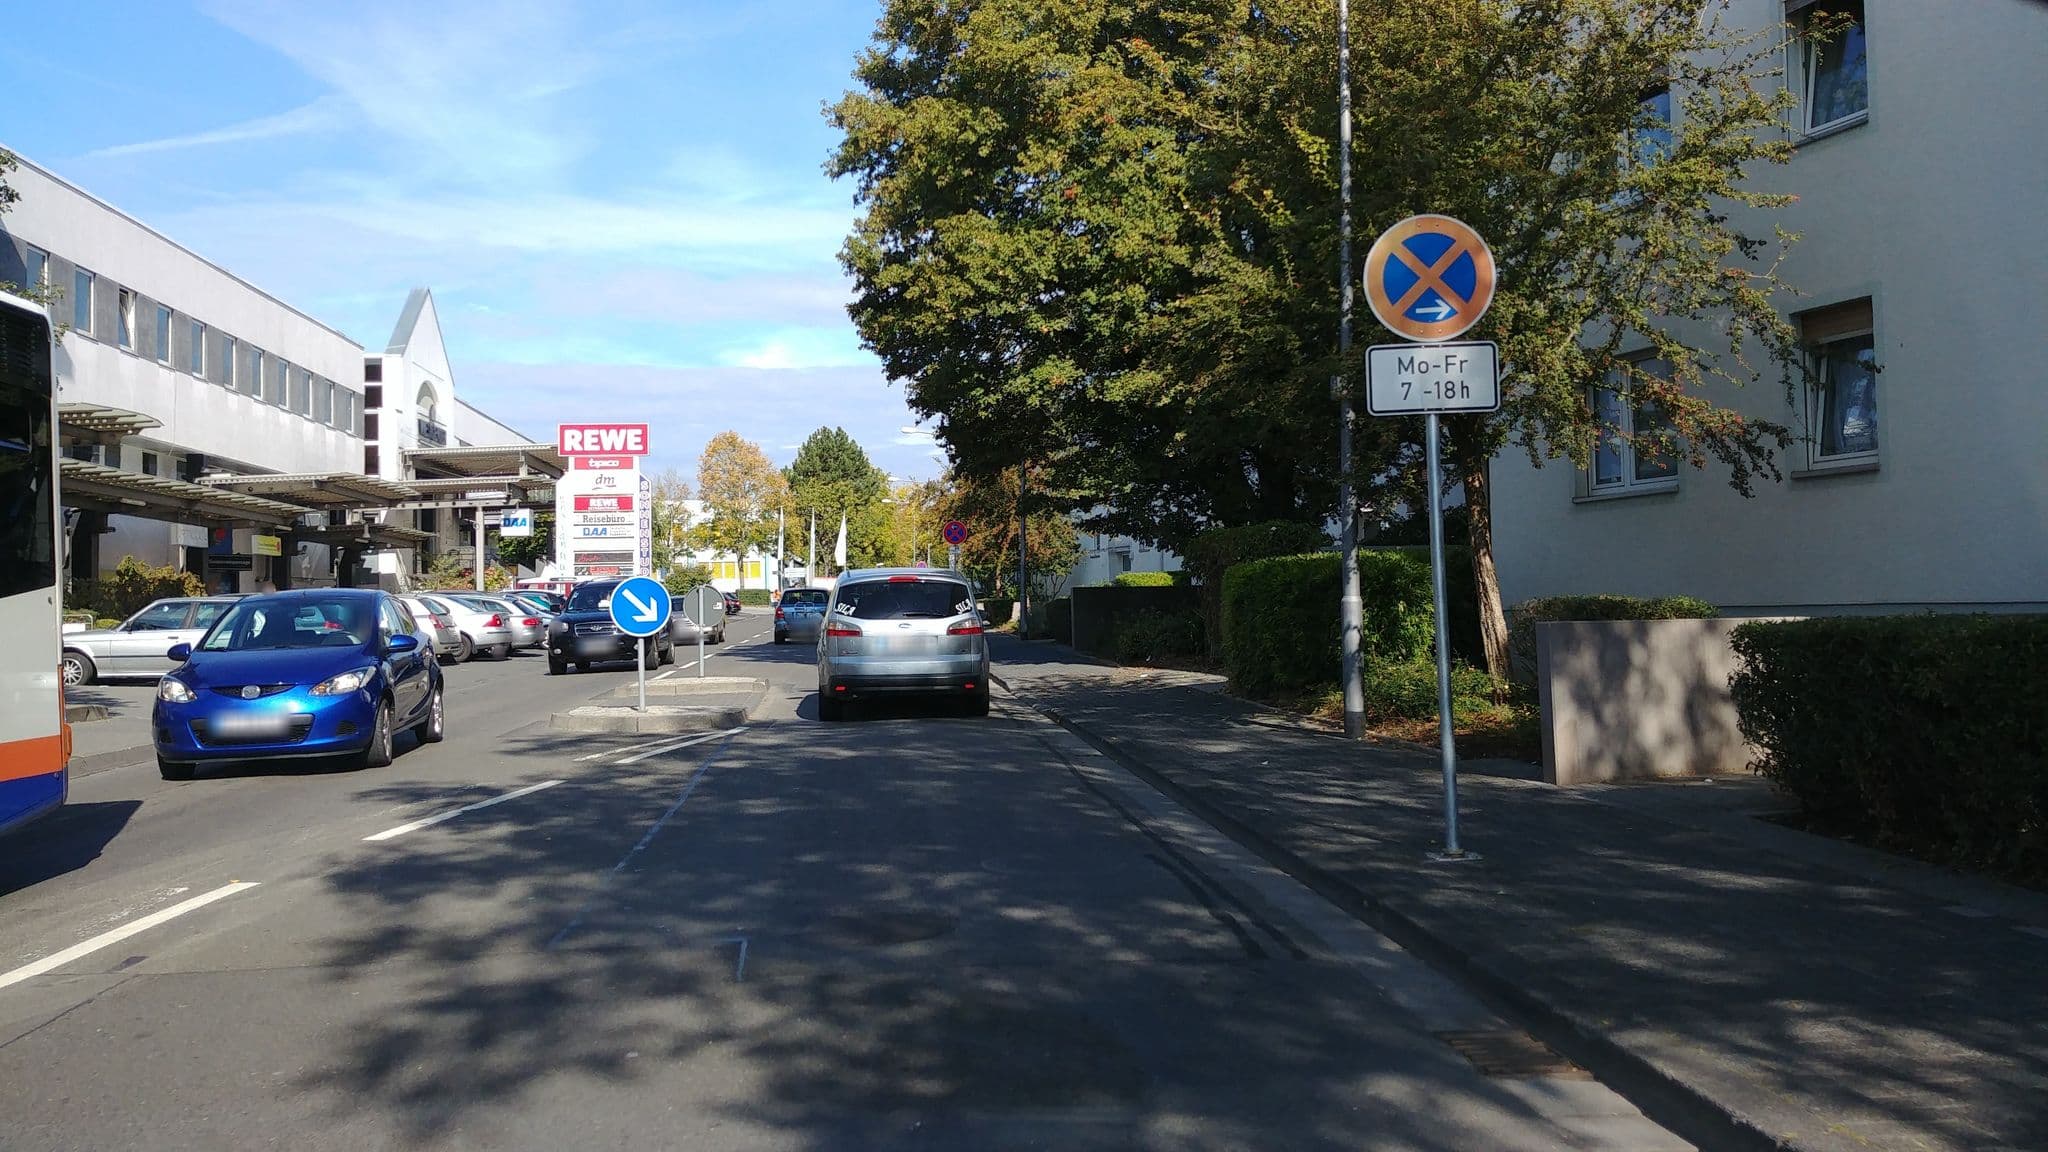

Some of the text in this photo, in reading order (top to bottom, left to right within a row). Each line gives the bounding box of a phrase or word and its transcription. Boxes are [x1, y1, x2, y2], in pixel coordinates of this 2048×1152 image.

[1398, 355, 1468, 375] Mo-Fr
[564, 429, 644, 451] REWE
[595, 473, 615, 486] dm
[503, 518, 527, 527] DAA
[583, 514, 626, 523] Reisebüro
[583, 527, 607, 536] DAA
